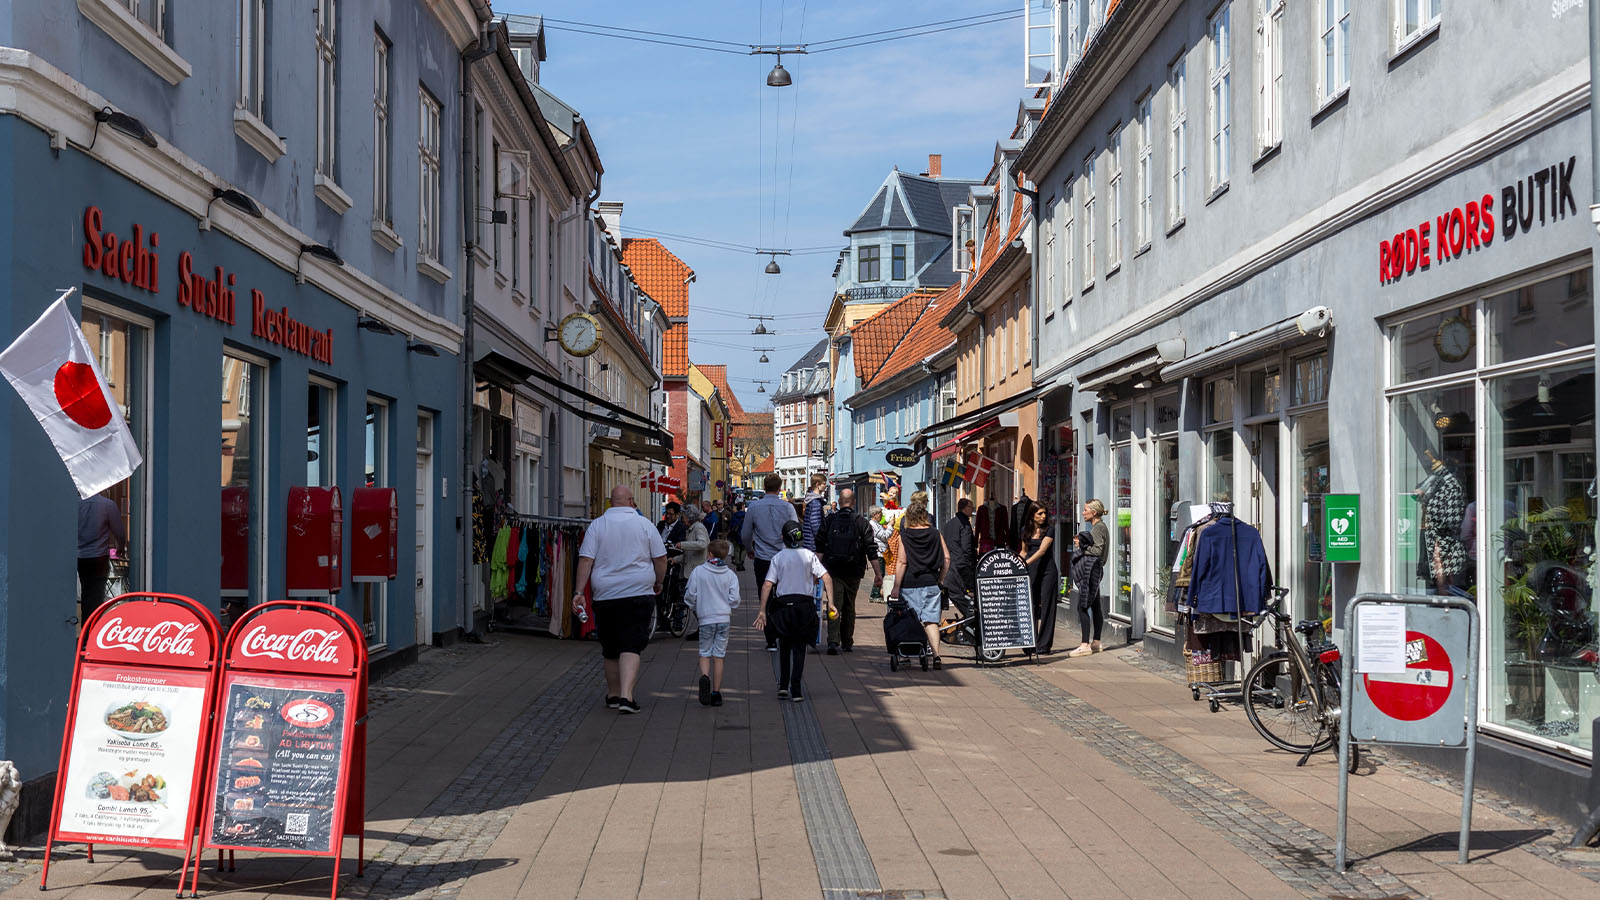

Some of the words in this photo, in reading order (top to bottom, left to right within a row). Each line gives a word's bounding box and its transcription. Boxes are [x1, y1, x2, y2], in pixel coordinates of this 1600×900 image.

[1379, 221, 1430, 284] RØDE
[1436, 194, 1495, 262] KORS
[1501, 155, 1578, 240] BUTIK
[83, 205, 160, 294] Sachi
[177, 250, 237, 326] Sushi
[251, 288, 334, 366] Restaurant
[980, 554, 1000, 572] SALON
[1000, 552, 1025, 570] BEAUTY
[96, 617, 200, 656] Coca-Cola
[240, 625, 343, 663] Coca-Cola
[1406, 641, 1422, 653] AN
[115, 673, 167, 685] Frokostmenuer
[107, 738, 130, 746] Yakisoba
[279, 739, 292, 747] AD
[295, 740, 335, 750] LIBITUM
[275, 749, 291, 759] (All
[291, 752, 304, 761] you
[320, 753, 335, 763] eat)
[97, 804, 117, 812] Combi
[119, 805, 137, 813] Lunch
[139, 807, 152, 815] 95,-
